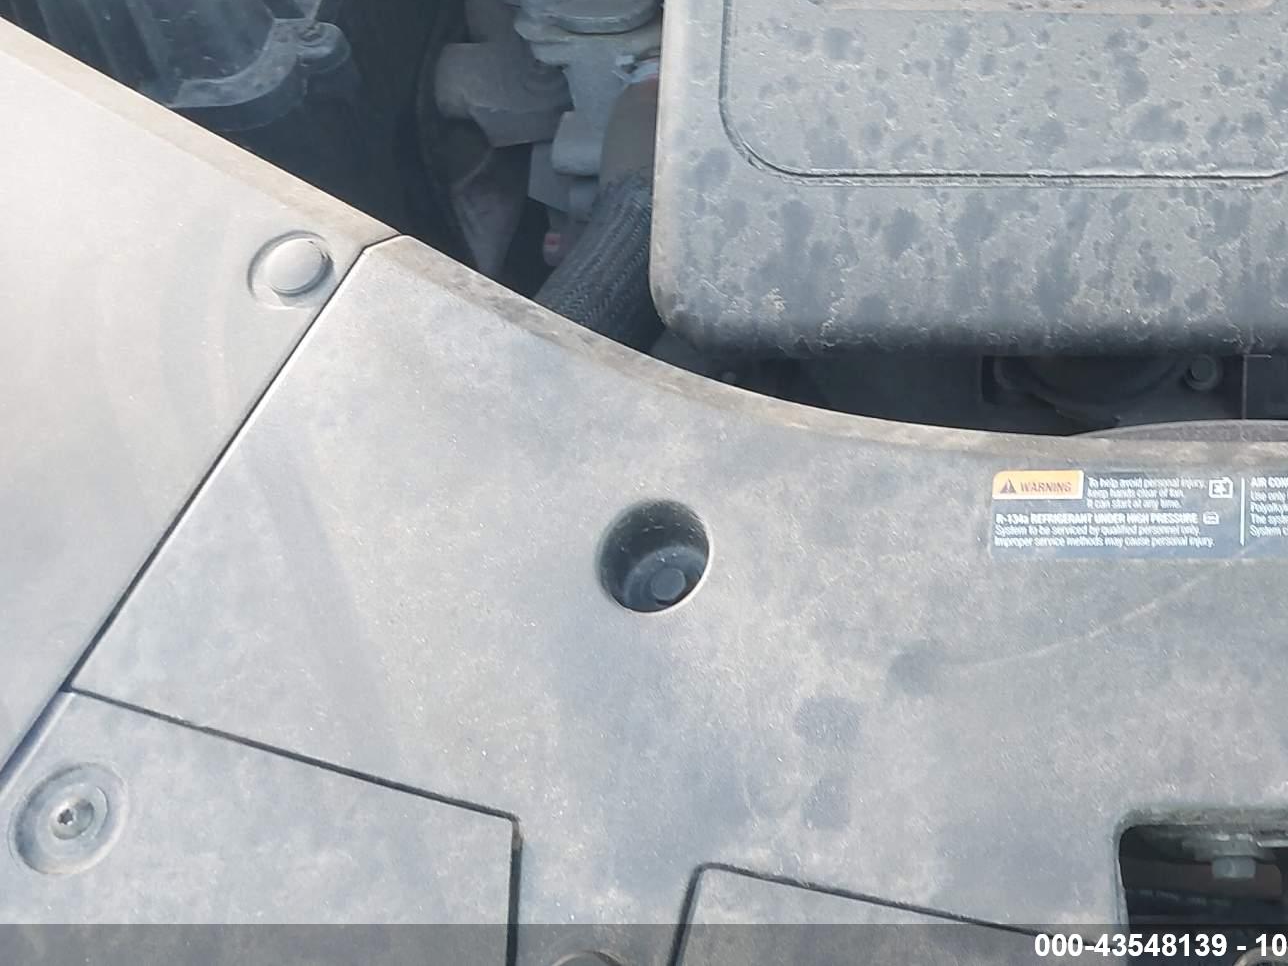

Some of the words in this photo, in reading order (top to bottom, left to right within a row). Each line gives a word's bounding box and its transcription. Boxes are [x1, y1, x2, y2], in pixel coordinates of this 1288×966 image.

[1020, 481, 1072, 493] WARNING
[1119, 478, 1143, 488] avoid
[1143, 478, 1180, 490] personal
[1251, 477, 1267, 488] AIR
[1110, 489, 1136, 499] hands
[1137, 489, 1158, 499] clear
[1094, 499, 1110, 509] can
[1111, 499, 1132, 509] start
[996, 513, 1029, 524] R-134a
[1030, 513, 1093, 524] REFRIGERANT
[1094, 513, 1125, 524] UNDER
[1127, 513, 1149, 524] HIGH
[1150, 513, 1198, 524] PRESSURE
[995, 525, 1028, 536] System
[1039, 525, 1050, 535] be
[1051, 525, 1088, 535] serviced
[1089, 525, 1100, 537] by
[1101, 525, 1137, 536] qualified
[1138, 525, 1180, 536] personnel
[994, 536, 1033, 547] Improper
[1034, 537, 1065, 546] service
[1066, 536, 1104, 546] methods
[1105, 536, 1123, 547] may
[1124, 537, 1150, 546] cause
[1151, 536, 1188, 547] personal
